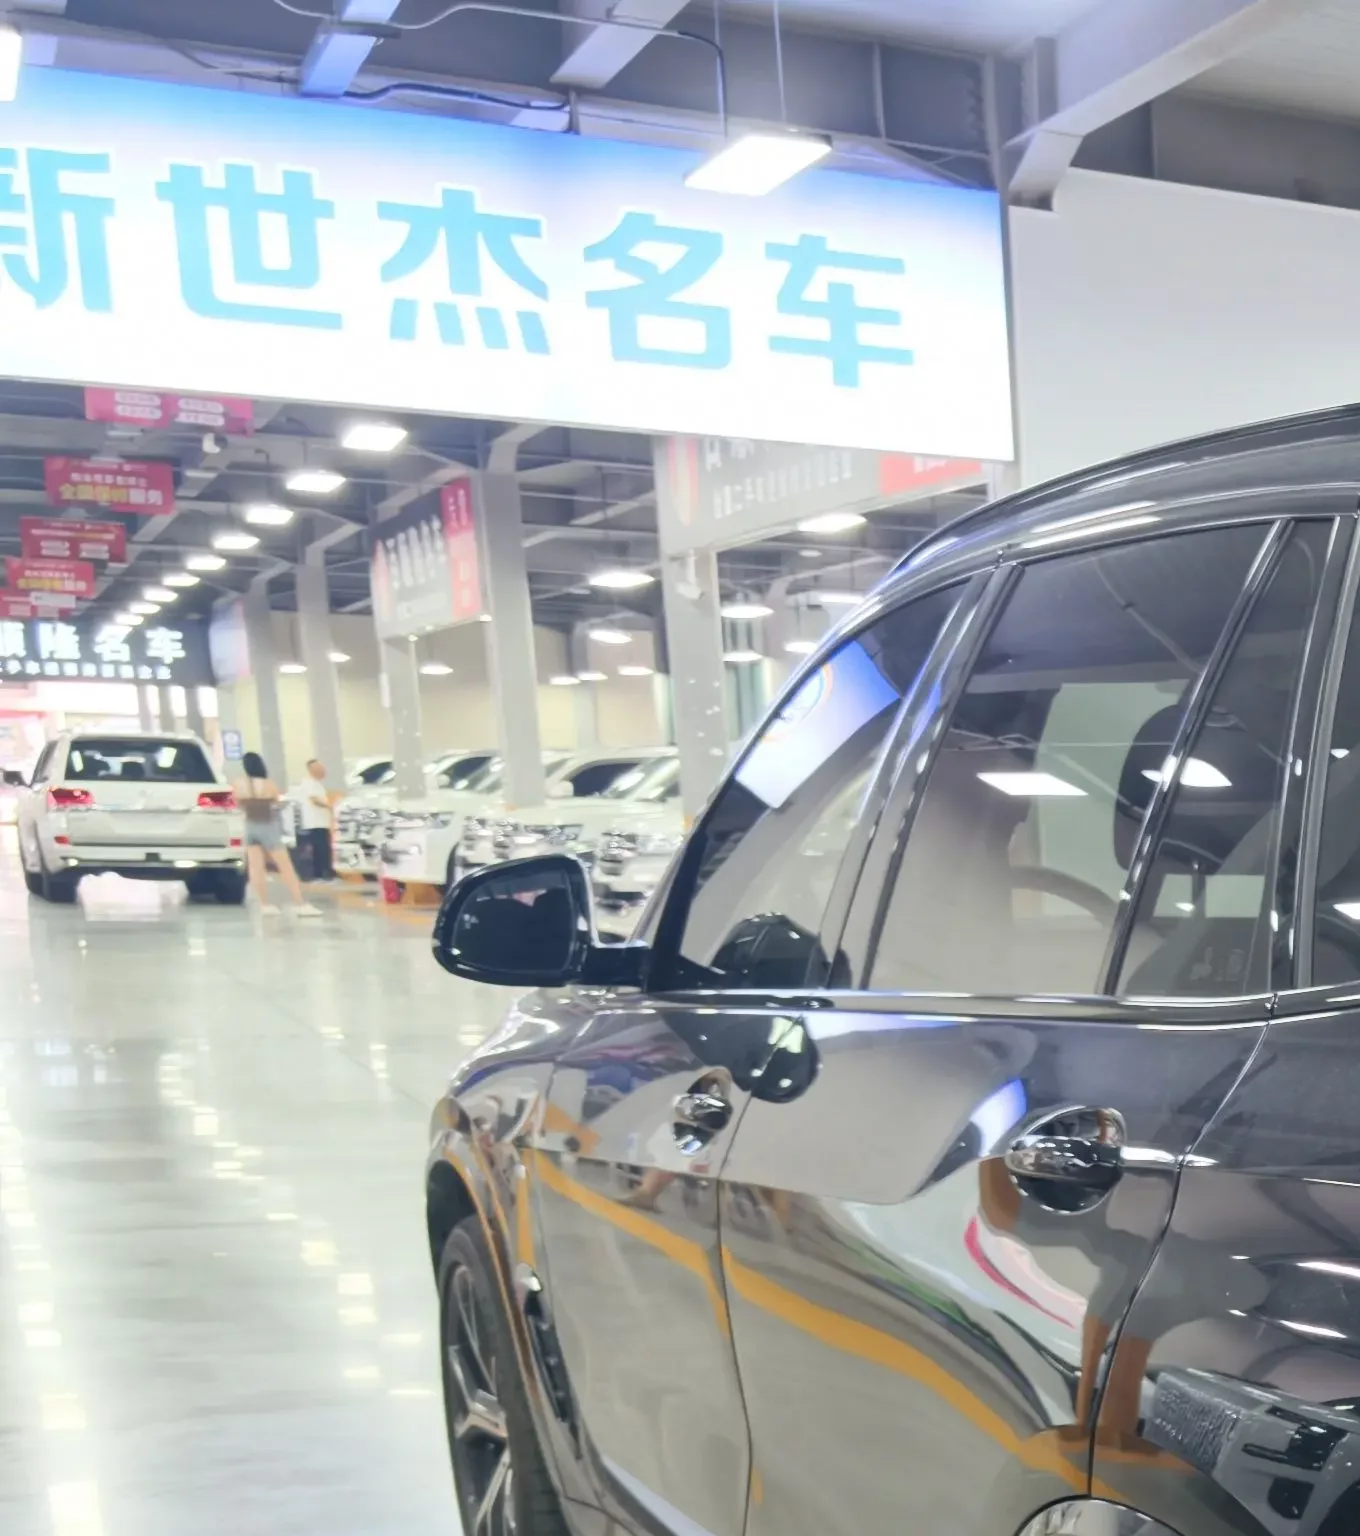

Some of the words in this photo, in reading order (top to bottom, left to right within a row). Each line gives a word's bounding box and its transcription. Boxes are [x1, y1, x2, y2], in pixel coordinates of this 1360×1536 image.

[0, 146, 915, 389] 新世杰名车
